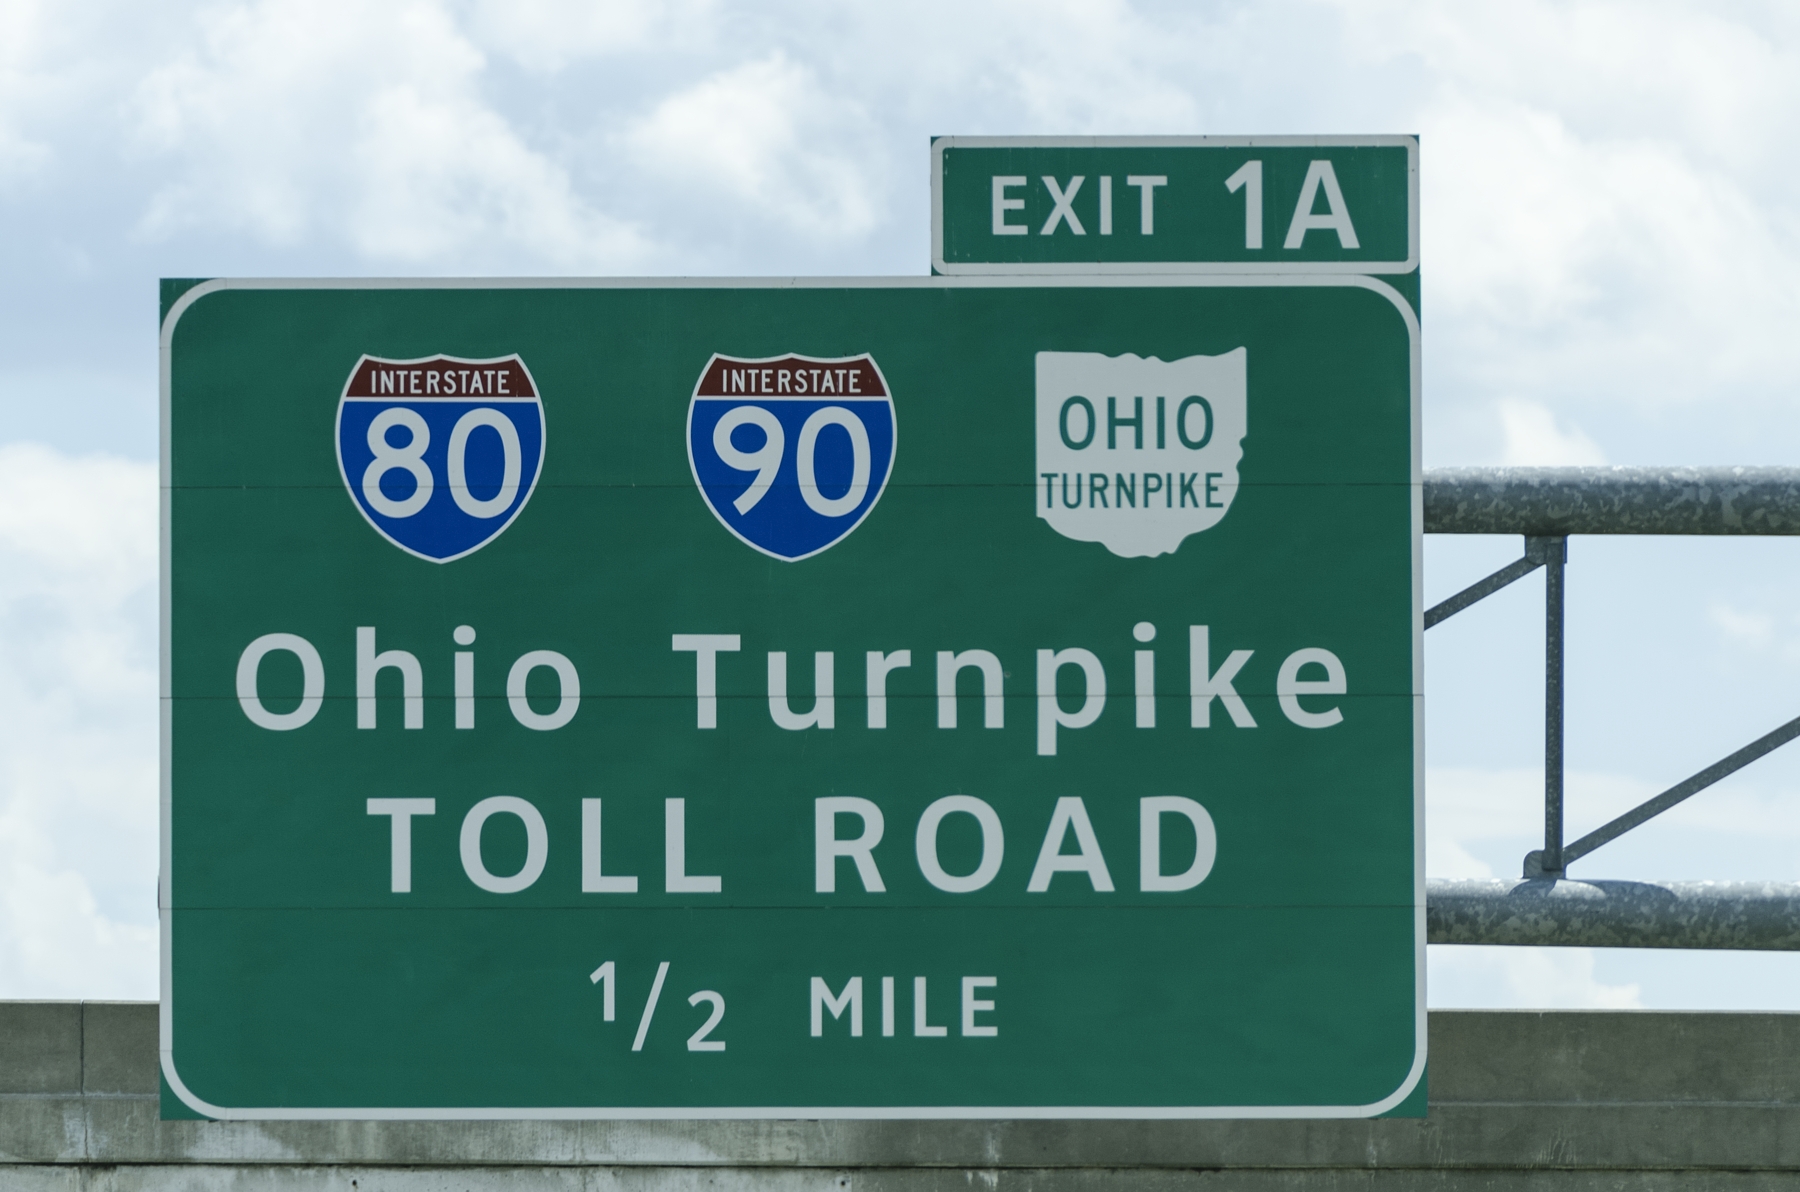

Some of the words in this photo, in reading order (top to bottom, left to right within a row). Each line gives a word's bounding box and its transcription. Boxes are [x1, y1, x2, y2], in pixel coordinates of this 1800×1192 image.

[992, 175, 1168, 236] EXIT
[1224, 160, 1360, 249] 1A
[371, 370, 510, 394] INTERSTATE
[722, 369, 861, 393] INTERSTATE
[1059, 395, 1214, 450] OHIO
[362, 407, 522, 519] 80
[712, 405, 871, 518] 90
[1041, 473, 1224, 509] TURNPIKE
[236, 625, 581, 731] Ohio
[672, 622, 1347, 756] Turnpike
[367, 796, 722, 893] TOLL
[815, 795, 1217, 893] ROAD
[590, 961, 726, 1052] 1/2
[811, 976, 998, 1037] MILE
